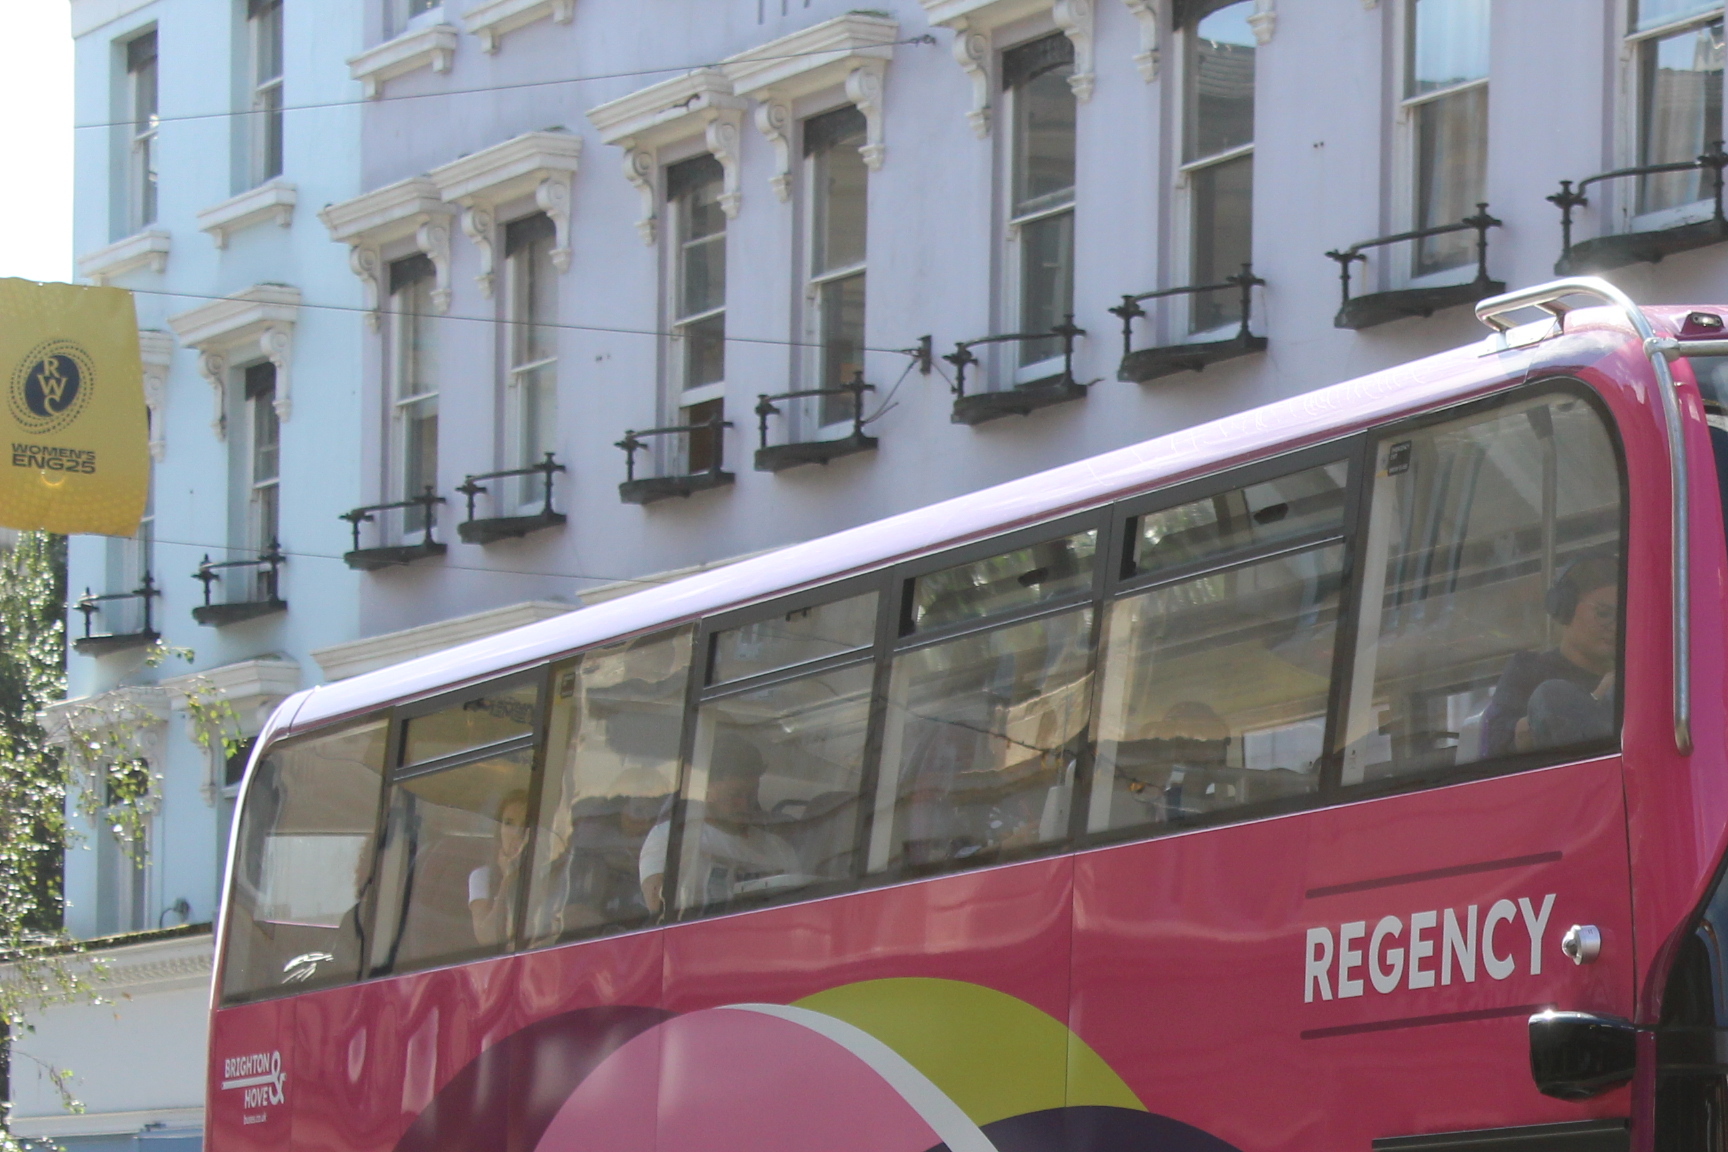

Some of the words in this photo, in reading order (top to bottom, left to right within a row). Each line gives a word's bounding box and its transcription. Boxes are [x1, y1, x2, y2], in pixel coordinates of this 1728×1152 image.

[11, 442, 96, 461] WOMEN'S
[12, 453, 96, 475] ENG25
[1304, 893, 1557, 1003] REGENCY
[225, 1052, 270, 1079] BRIGHTON
[244, 1086, 268, 1109] HOVE
